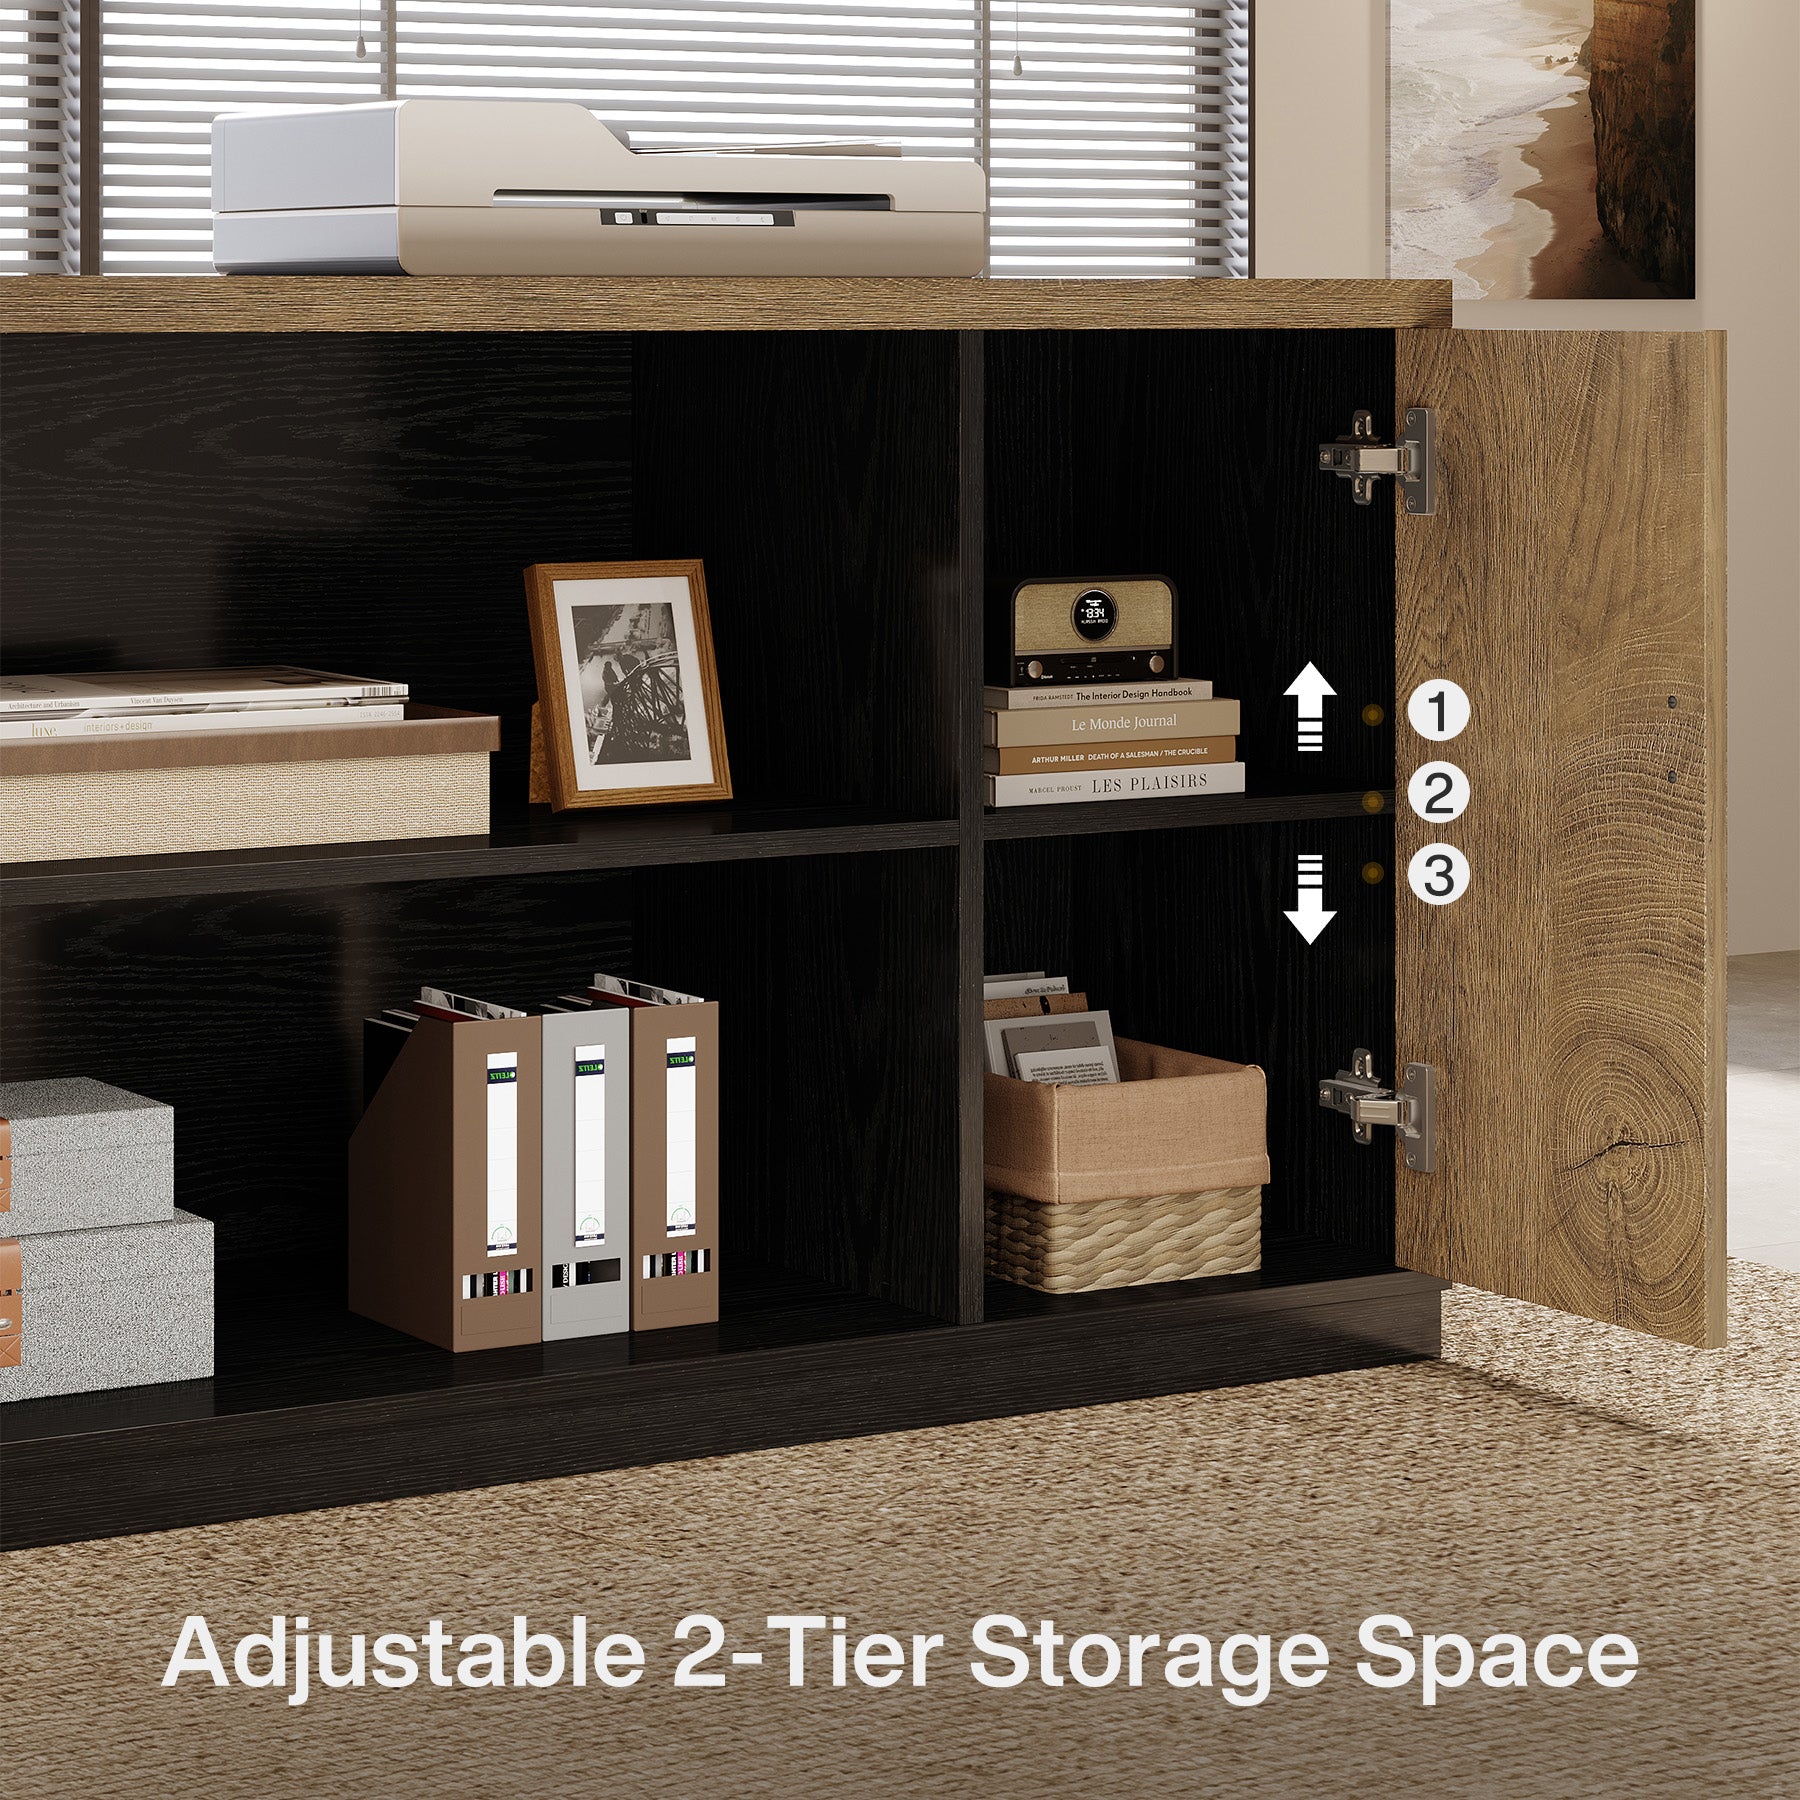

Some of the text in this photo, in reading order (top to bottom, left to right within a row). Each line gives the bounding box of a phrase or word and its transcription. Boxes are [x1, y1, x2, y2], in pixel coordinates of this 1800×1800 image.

[1076, 687, 1193, 701] The Interior Design Handbook
[8, 703, 42, 711] Architecture
[1072, 714, 1177, 731] Le Monde Journal
[1031, 754, 1085, 764] ARTHUR MILLER
[1088, 752, 1109, 761] DEATH
[1110, 752, 1119, 760] OF
[1126, 750, 1159, 759] SALESMAN
[1177, 747, 1208, 756] CRUCIBLE
[1092, 773, 1208, 793] LES PLAISIRS
